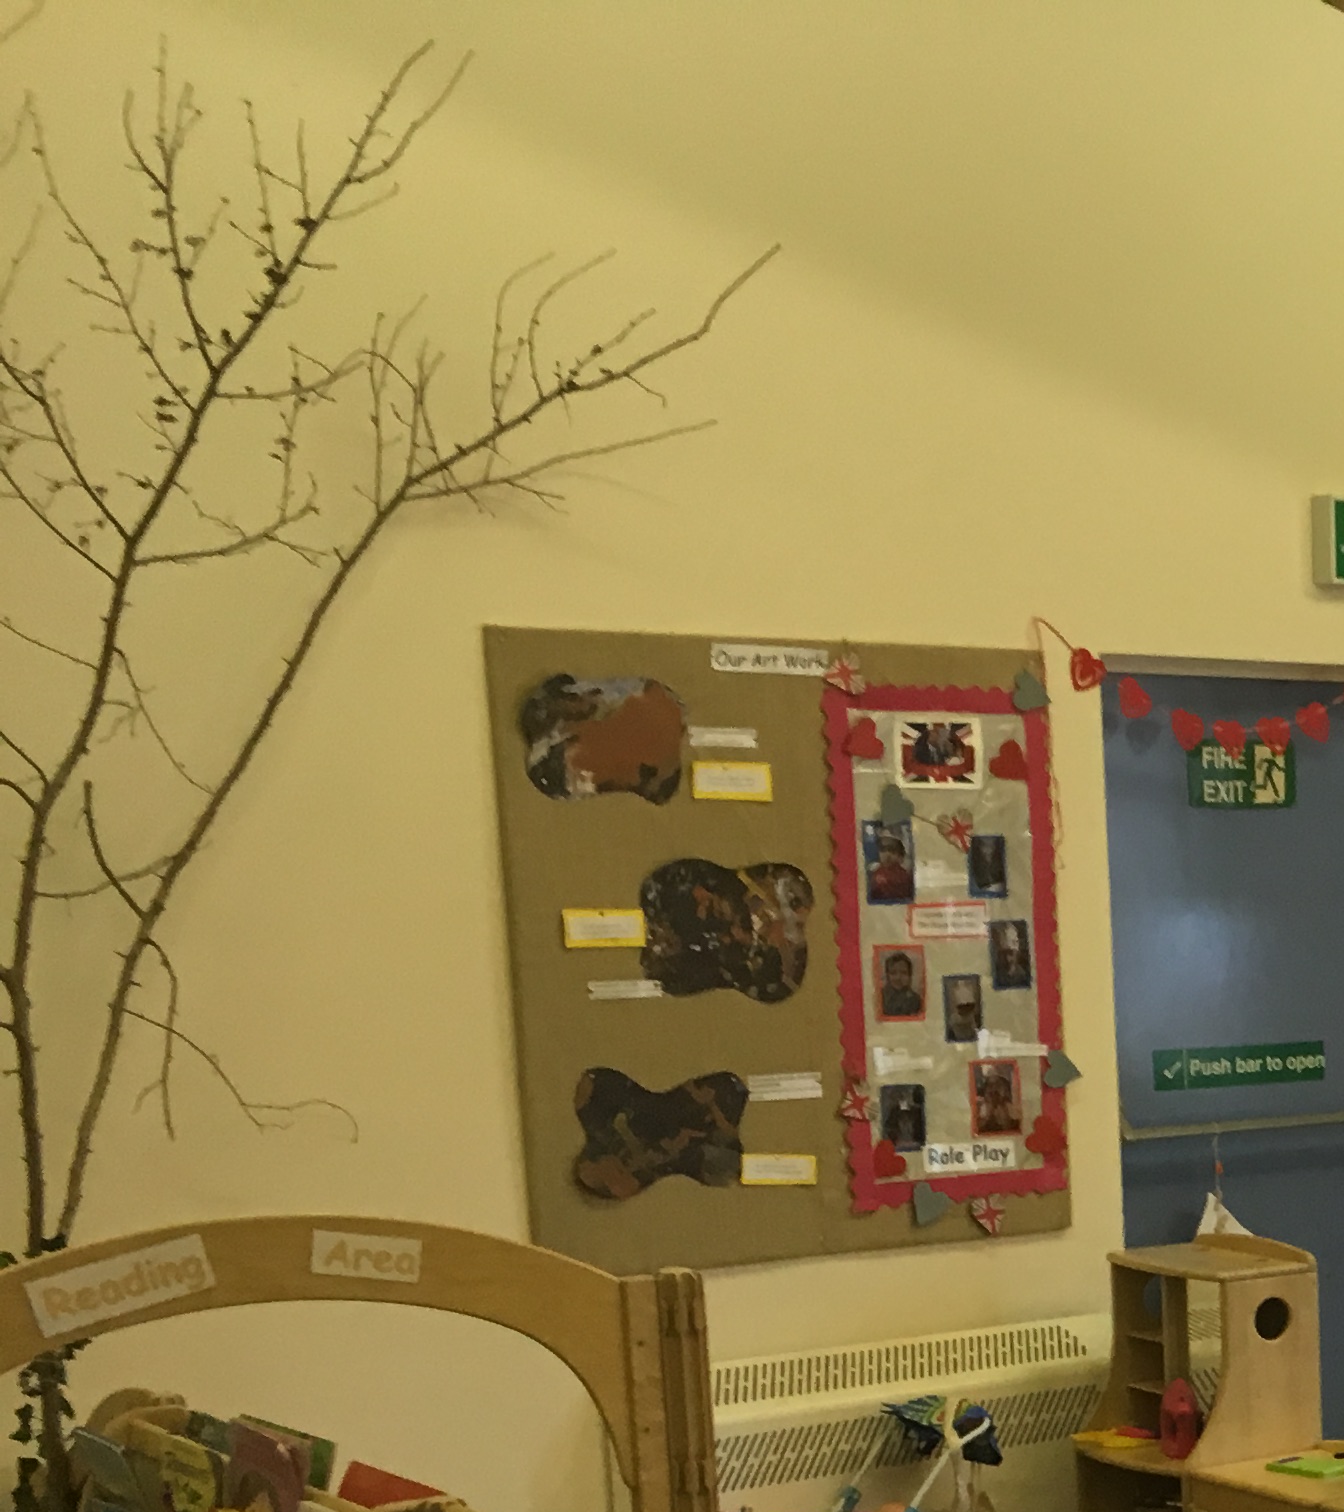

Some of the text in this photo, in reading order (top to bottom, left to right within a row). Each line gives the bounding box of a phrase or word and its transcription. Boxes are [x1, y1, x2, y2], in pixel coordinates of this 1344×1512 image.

[715, 649, 829, 669] Our Art Work
[1202, 745, 1247, 770] FIRE
[1203, 780, 1247, 803] EXIT
[1189, 1053, 1326, 1077] Push bar to open
[927, 1144, 1010, 1166] Role Play
[40, 1239, 415, 1321] Reading Area
